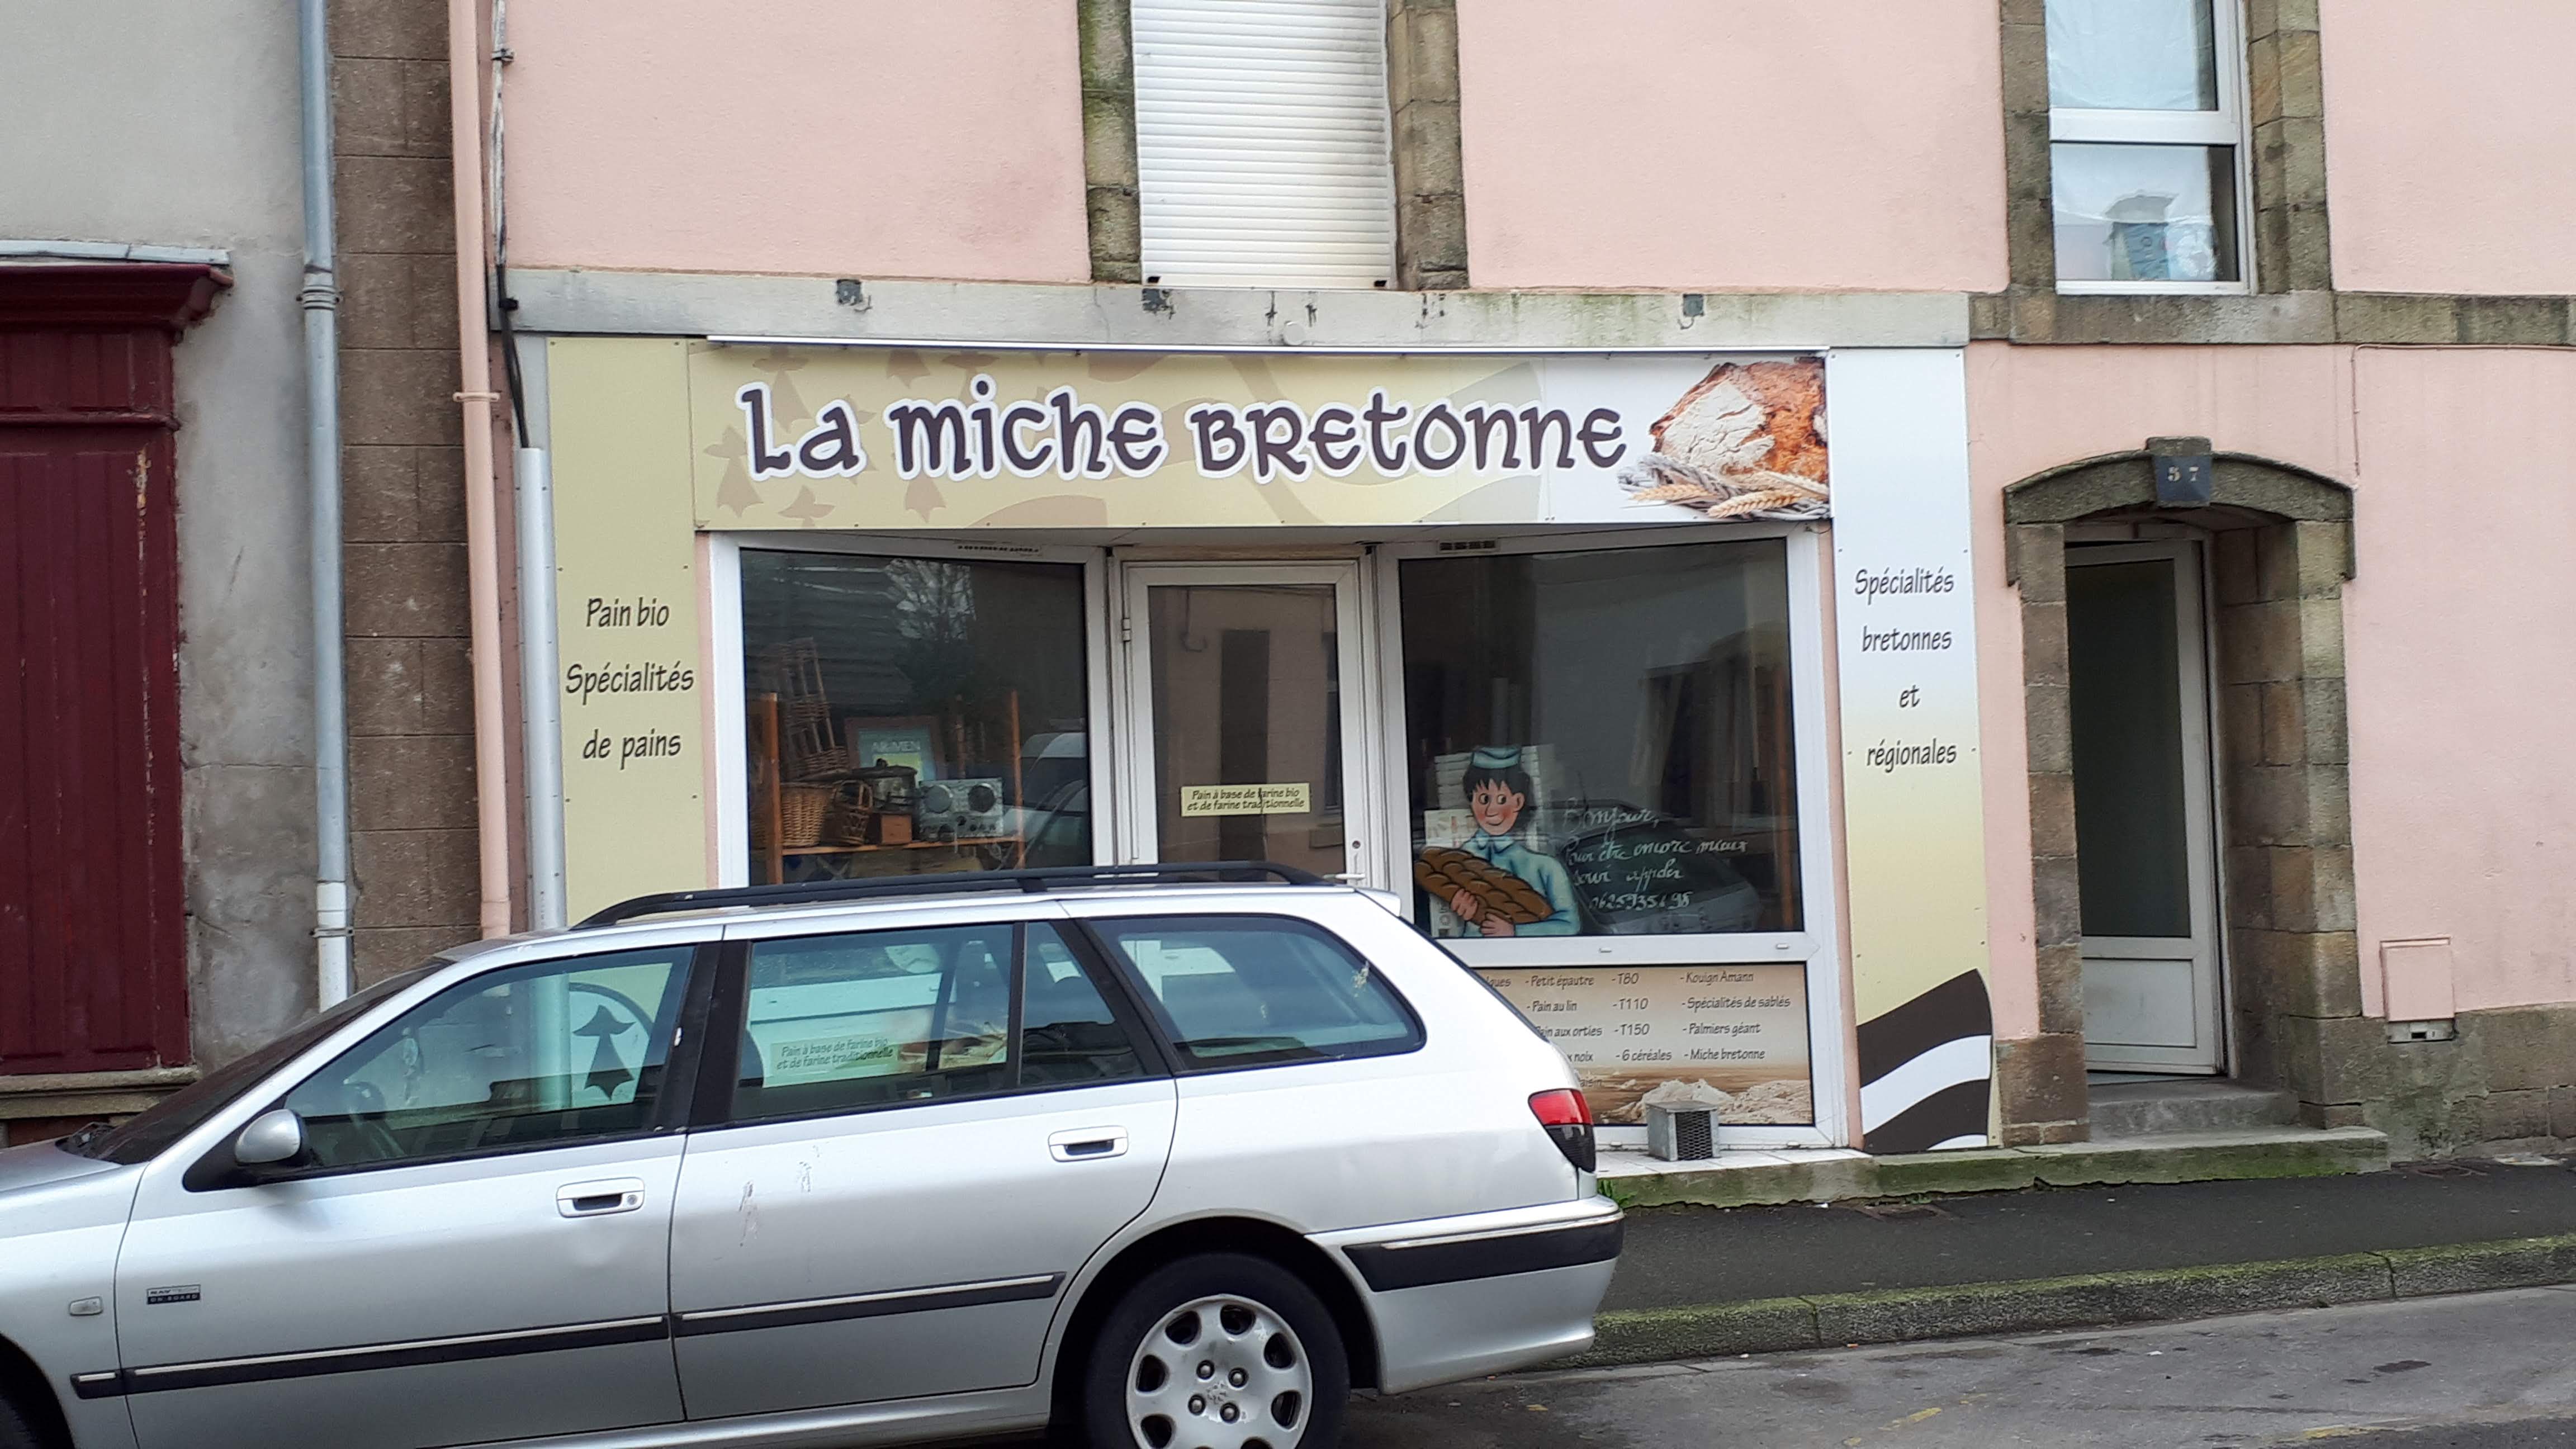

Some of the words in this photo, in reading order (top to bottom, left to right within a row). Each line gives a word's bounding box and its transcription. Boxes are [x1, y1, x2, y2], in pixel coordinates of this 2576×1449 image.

[739, 387, 860, 475] La
[887, 379, 1164, 475] miche
[1854, 566, 1955, 605] Spécialités
[586, 597, 631, 627] Pain
[637, 596, 670, 627] bio
[1861, 625, 1953, 652] bretonnes
[565, 660, 695, 706] Spécialités
[1899, 684, 1920, 708] et
[582, 728, 612, 759] de
[619, 727, 681, 770] pains
[1865, 737, 1957, 773] régionales
[1191, 790, 1211, 800] Pain
[1213, 789, 1219, 799] à
[1220, 788, 1242, 799] base
[1243, 787, 1256, 799] de
[1286, 786, 1300, 797] bio
[1187, 801, 1199, 811] et
[1200, 799, 1212, 810] de
[1214, 799, 1240, 809] farine
[1633, 839, 1693, 857] encore
[1530, 975, 1556, 987] Petit
[1556, 974, 1595, 991] épautre
[1617, 972, 1640, 985] T80
[1685, 972, 1719, 986] Kouign
[1532, 1000, 1552, 1012] Pain
[1552, 1003, 1565, 1012] au
[1566, 1000, 1578, 1011] lin
[1619, 997, 1649, 1010] T110
[1687, 996, 1742, 1014] Spécialités
[1744, 996, 1757, 1008] de
[1758, 995, 1791, 1008] sablés
[1555, 1028, 1572, 1037] aux
[1574, 1026, 1603, 1036] orties
[1621, 1024, 1650, 1036] T150
[1688, 1022, 1731, 1035] Palmiers
[1731, 1022, 1761, 1037] géant
[781, 1045, 802, 1057] Pain
[809, 1043, 833, 1054] base
[834, 1041, 845, 1051] de
[846, 1039, 873, 1050] farine
[1622, 1049, 1631, 1061] 6
[1631, 1049, 1673, 1061] céréales
[1689, 1048, 1719, 1060] Miche
[1720, 1048, 1766, 1060] bretonne
[776, 1059, 788, 1071] et
[789, 1057, 802, 1069] de
[803, 1055, 831, 1067] farine
[831, 1046, 894, 1063] traditionnelle
[1574, 1051, 1594, 1063] noix
[1579, 1076, 1603, 1087] aisin
